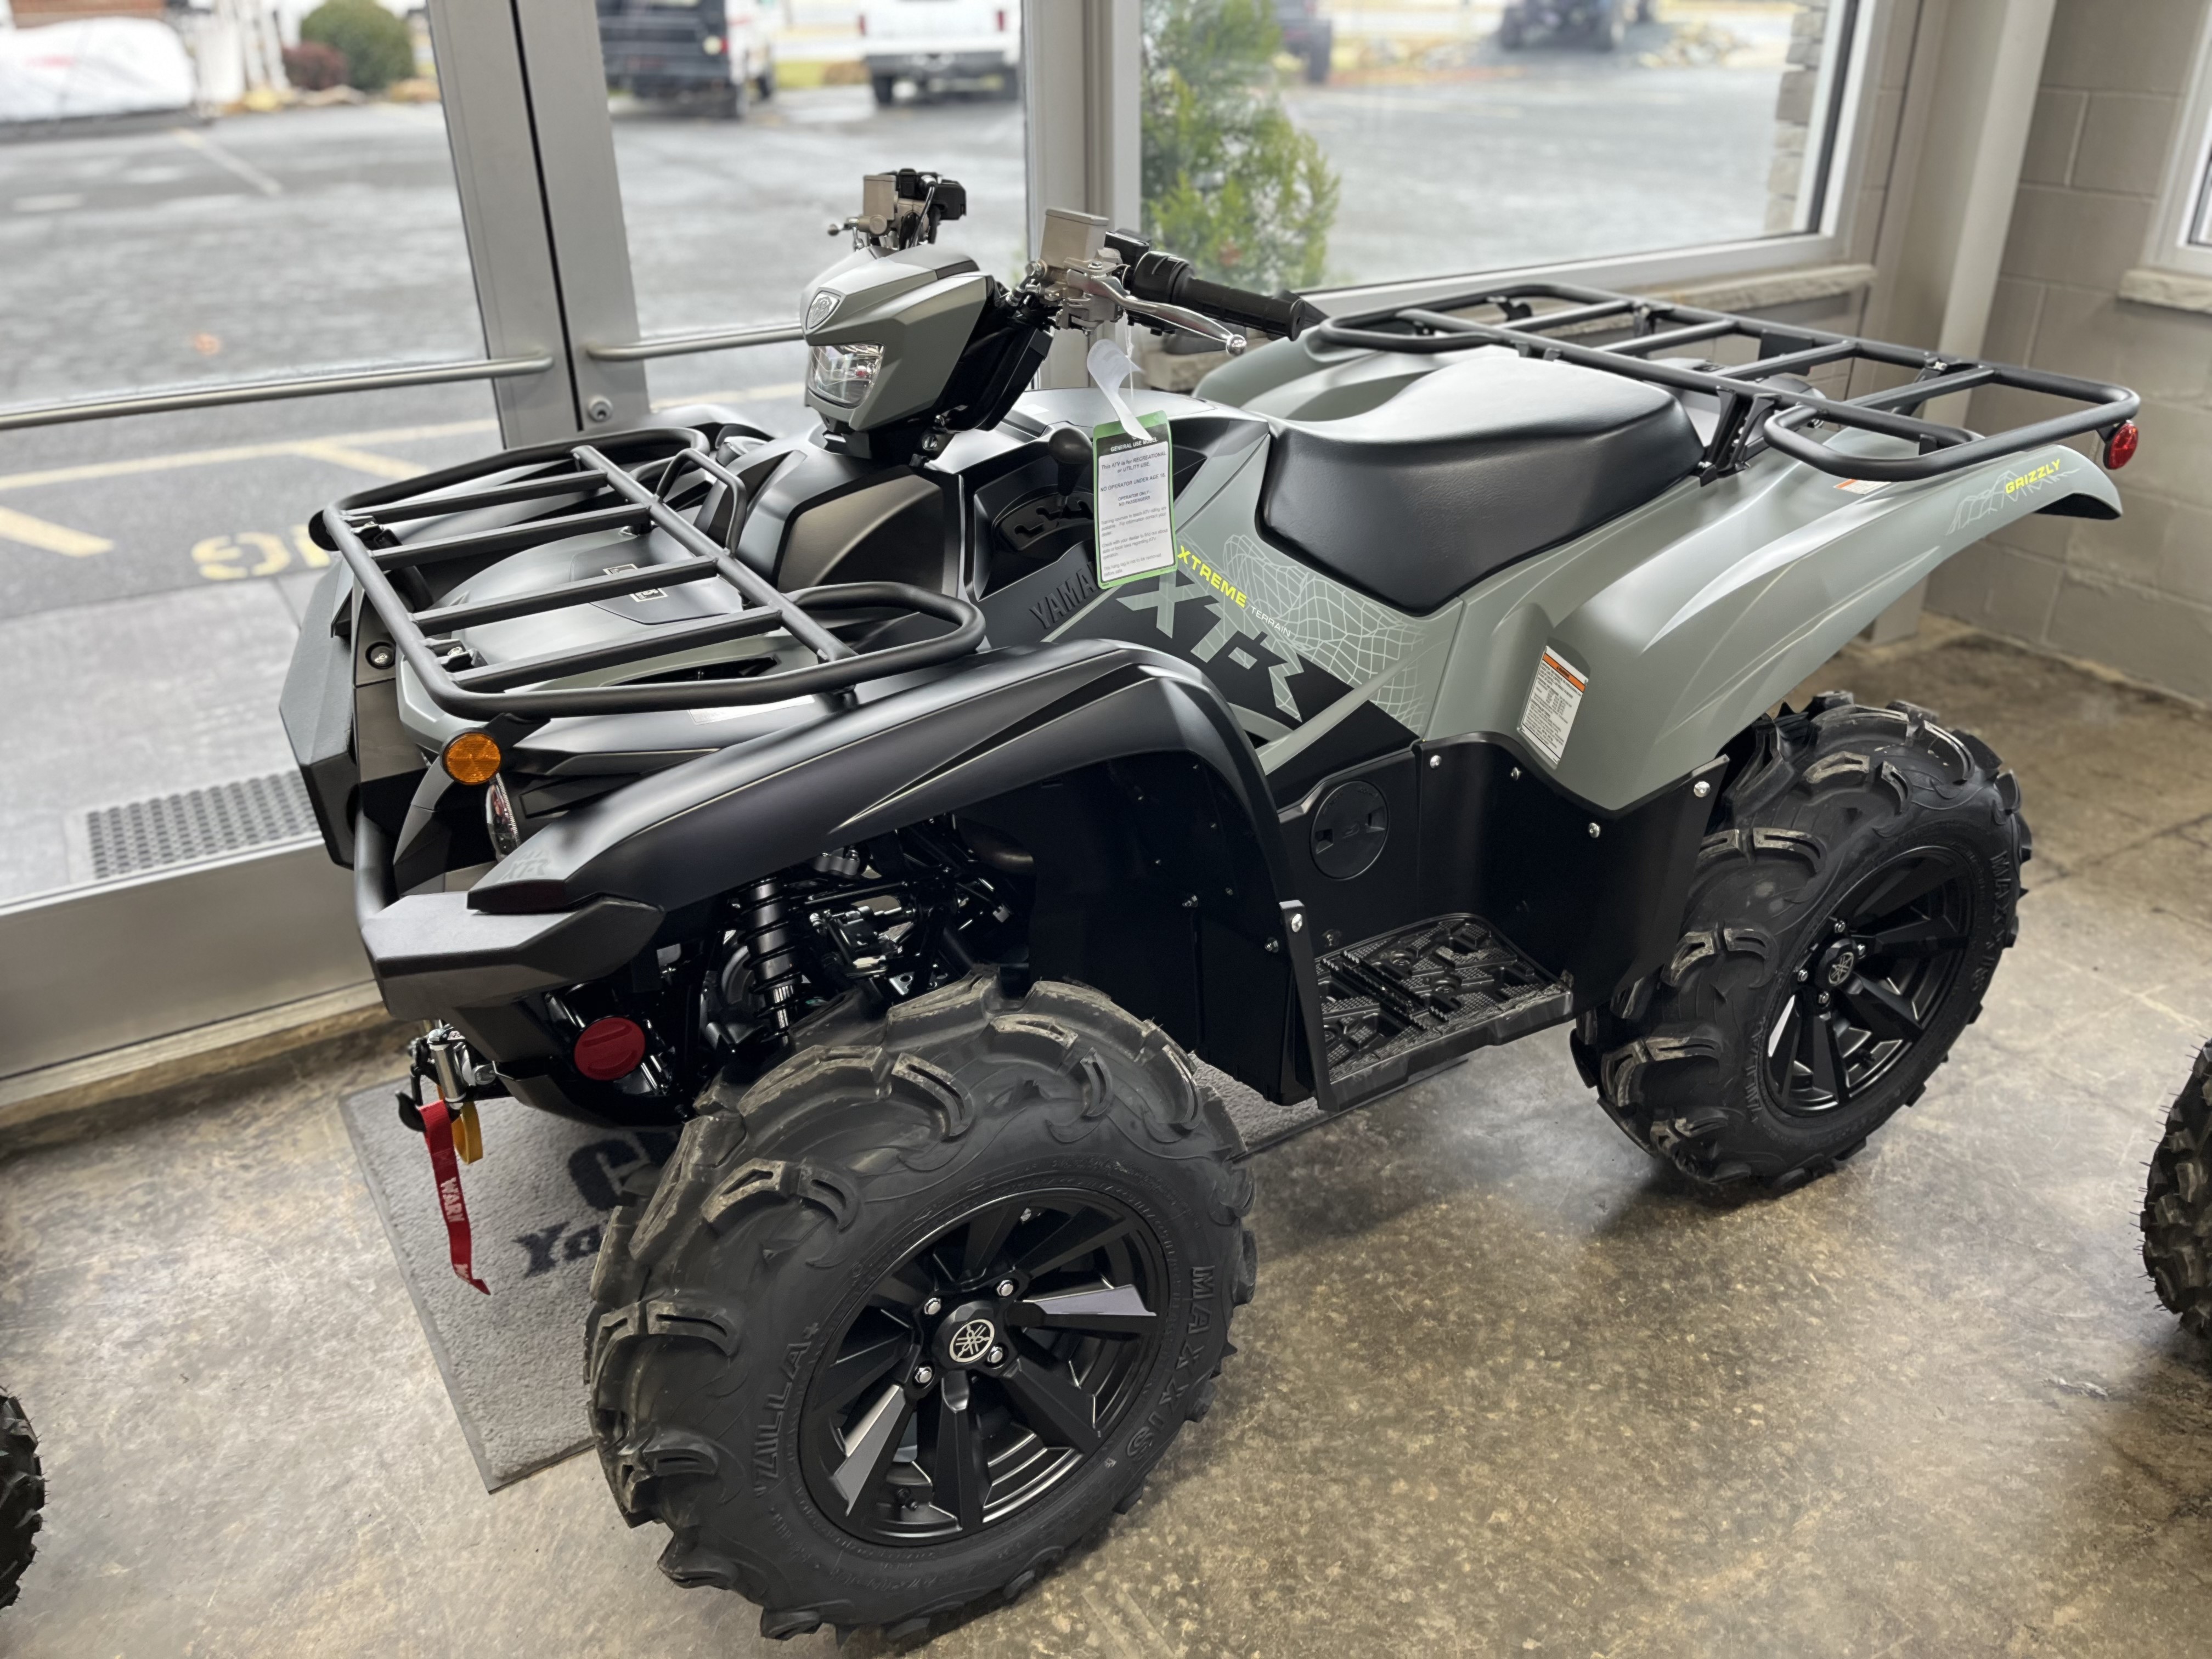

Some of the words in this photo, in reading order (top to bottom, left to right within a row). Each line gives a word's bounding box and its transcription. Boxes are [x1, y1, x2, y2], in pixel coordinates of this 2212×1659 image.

[1110, 443, 1132, 452] GENERAL
[1133, 451, 1166, 462] RECREATIONAL
[2005, 459, 2061, 494] GRIZZLY
[1108, 481, 1132, 490] OPERATOR
[1118, 493, 1138, 501] OPERATOR
[1125, 495, 1150, 505] PASSENGERS
[1029, 561, 1097, 630] YAMA
[1177, 545, 1248, 609] XTREME
[1251, 605, 1291, 637] TERRAIN
[1126, 1265, 1216, 1460] MAXXIS
